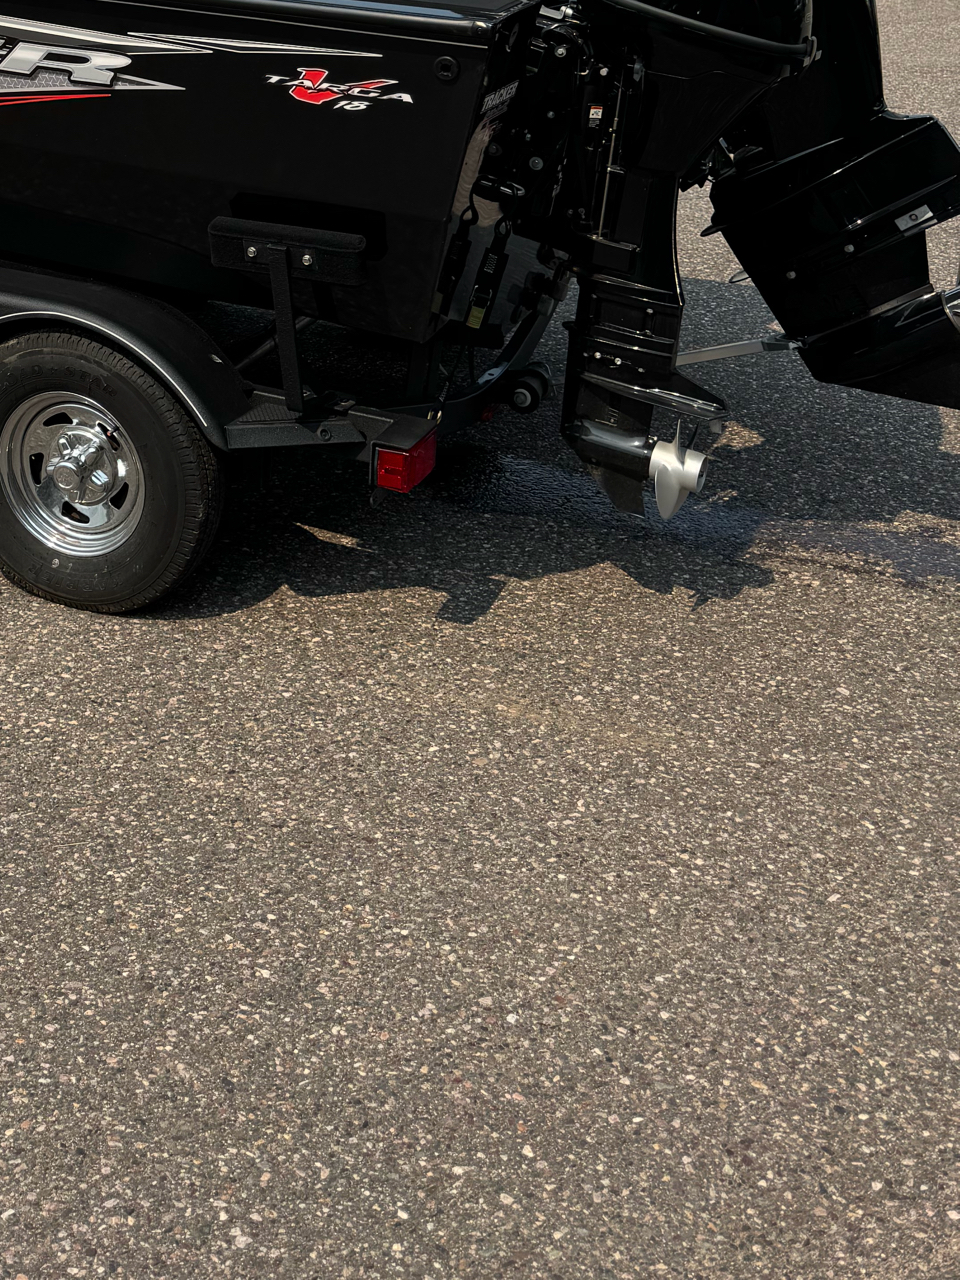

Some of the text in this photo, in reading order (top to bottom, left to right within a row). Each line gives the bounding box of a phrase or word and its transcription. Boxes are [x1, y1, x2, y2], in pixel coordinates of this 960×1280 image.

[265, 74, 414, 104] TARGA
[479, 79, 520, 115] TRACKER
[333, 100, 373, 111] 18
[63, 366, 118, 397] STAR
